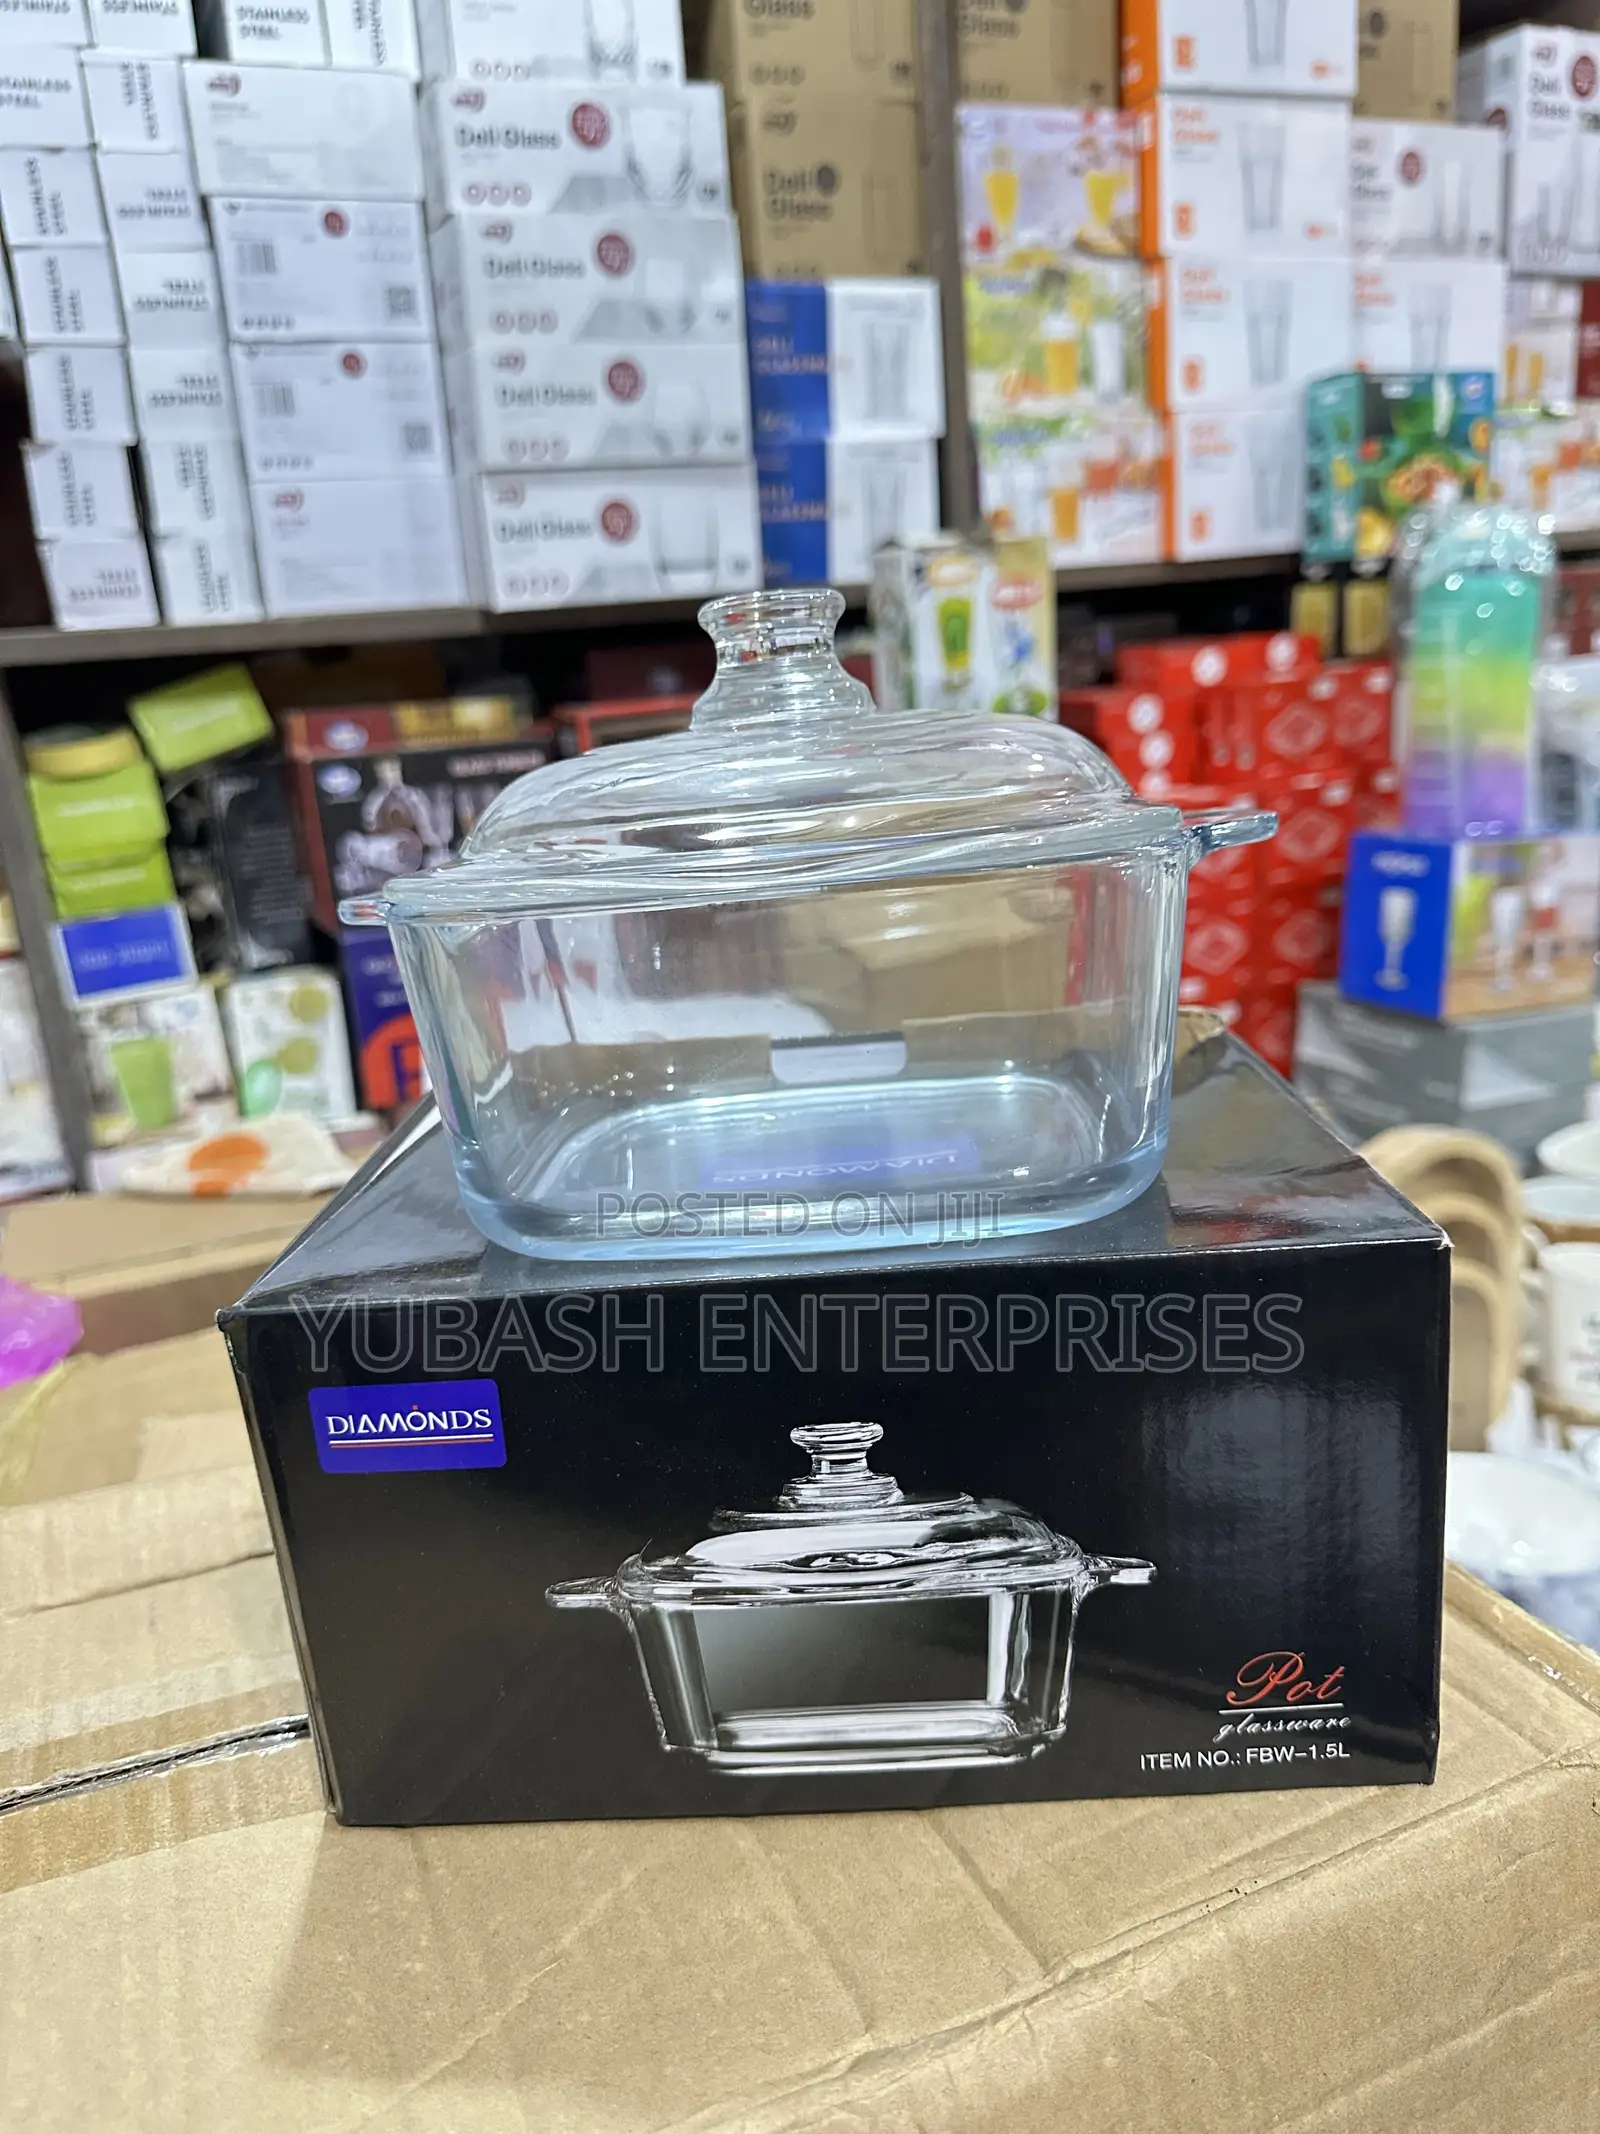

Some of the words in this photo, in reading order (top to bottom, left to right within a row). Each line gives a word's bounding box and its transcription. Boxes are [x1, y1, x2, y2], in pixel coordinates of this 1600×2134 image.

[325, 1406, 492, 1435] DIAMONDS
[1226, 1651, 1345, 1707] Pot
[1212, 1712, 1351, 1743] glassware
[1140, 1752, 1191, 1770] ITEM
[1197, 1750, 1241, 1768] NO.:
